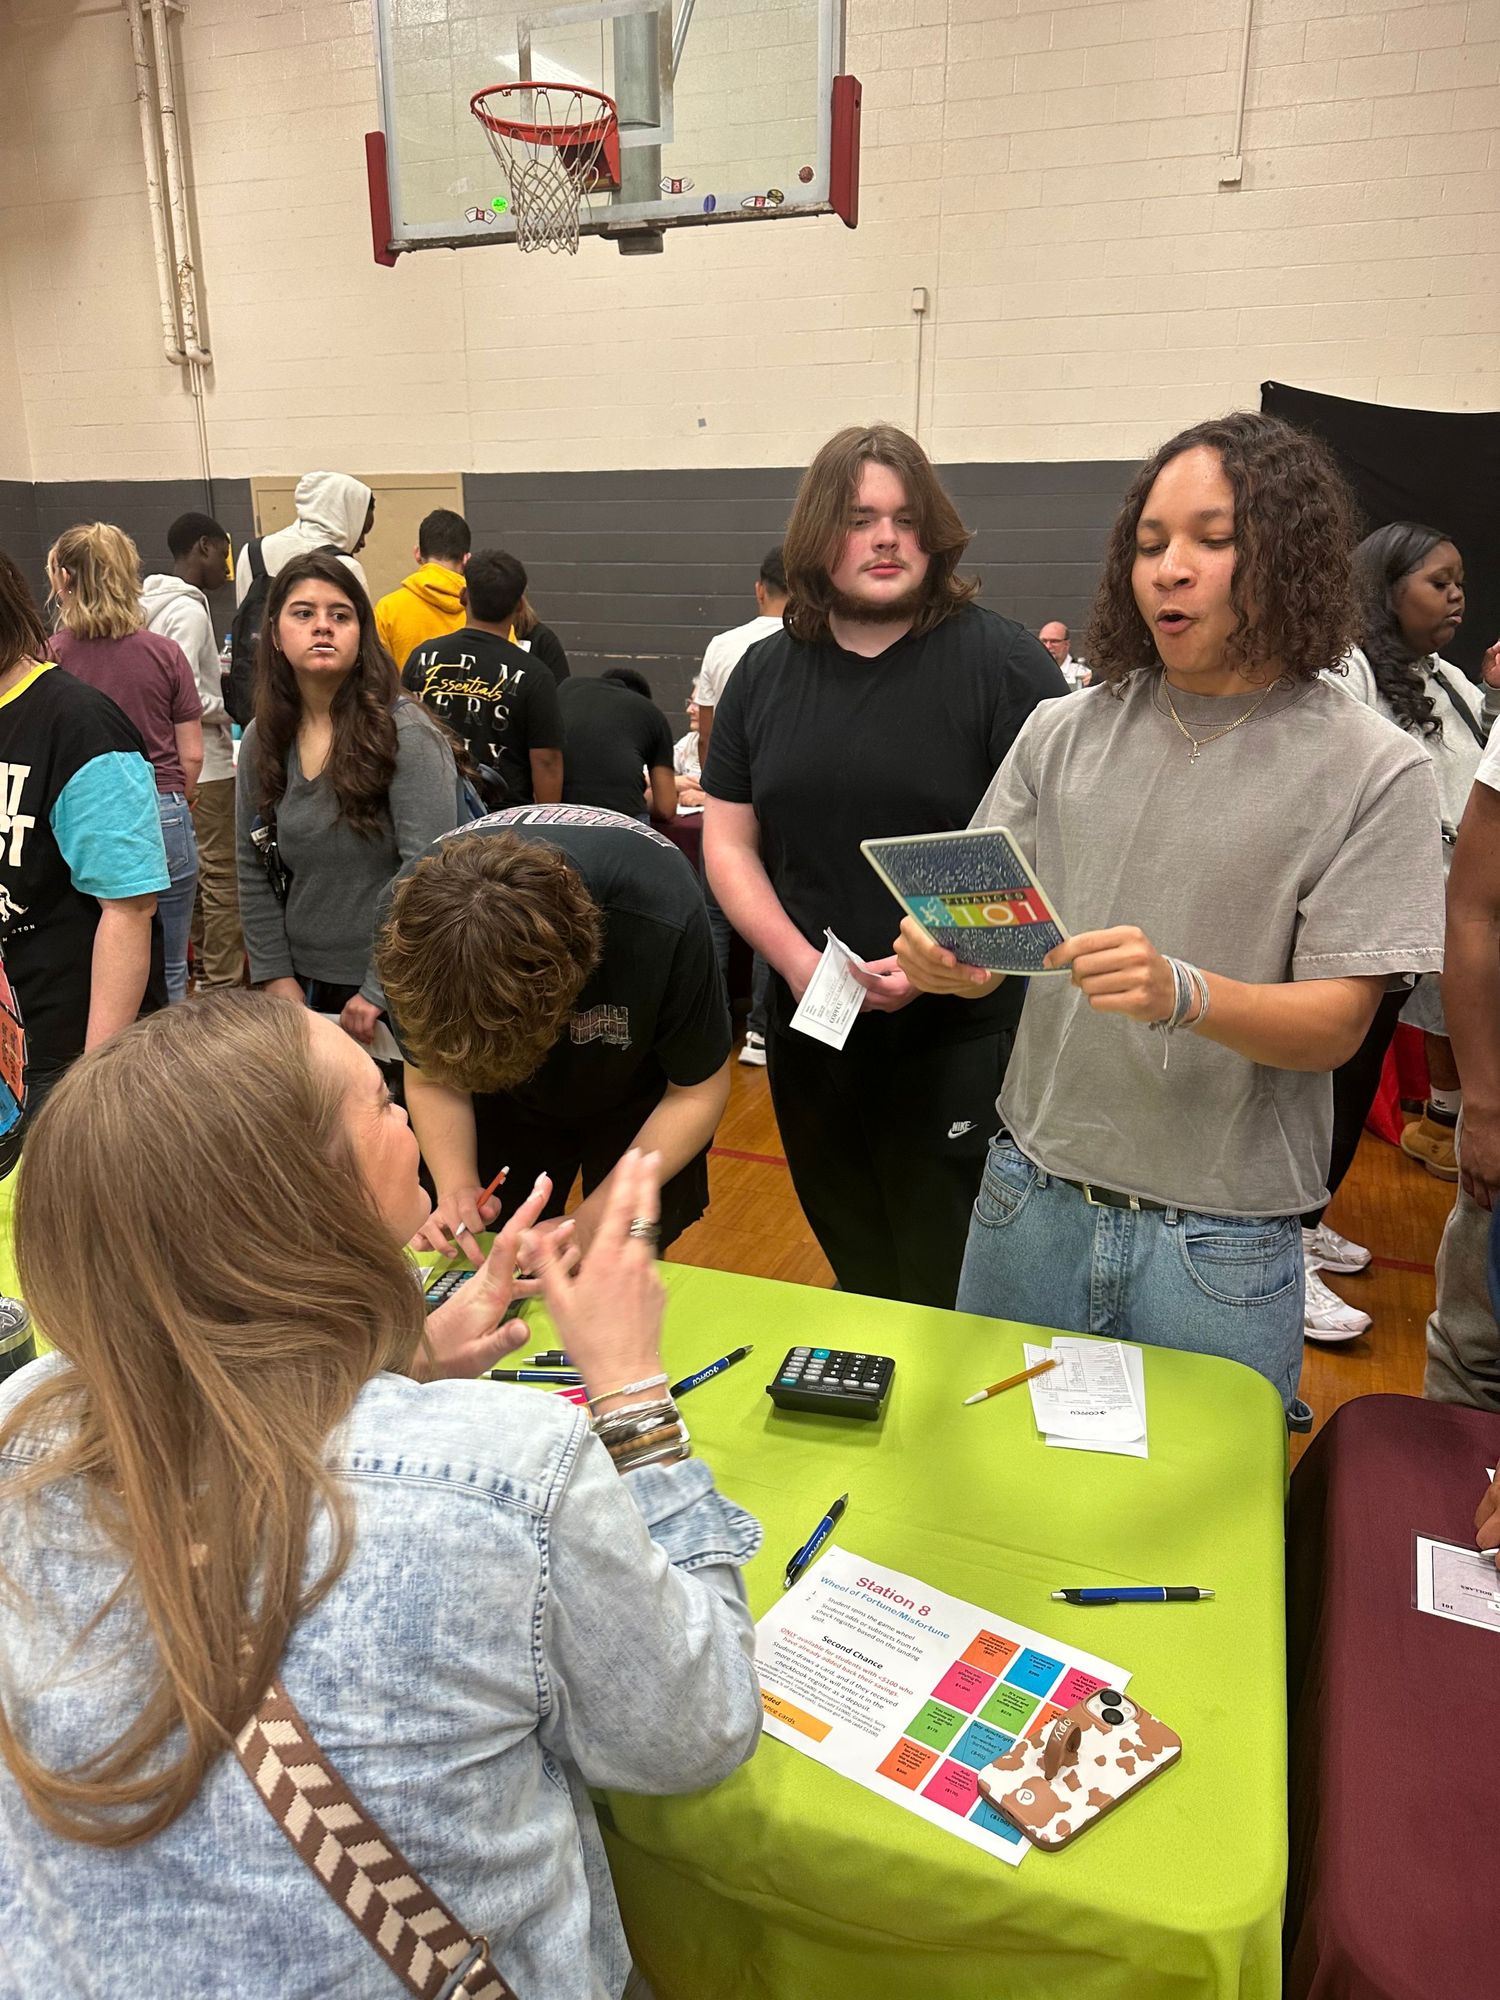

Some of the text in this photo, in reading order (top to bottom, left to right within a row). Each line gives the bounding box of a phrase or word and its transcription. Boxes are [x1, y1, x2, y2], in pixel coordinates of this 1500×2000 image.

[419, 663, 504, 703] Essentials
[957, 901, 1038, 925] 101
[951, 1120, 972, 1132] NIKE
[821, 1576, 849, 1592] Wheel
[861, 1593, 950, 1639] Fortune/Misfortune
[856, 1577, 931, 1616] Station 8
[816, 1609, 833, 1619] check
[833, 1617, 856, 1630] register
[856, 1627, 876, 1640] based
[885, 1642, 896, 1650] the
[896, 1647, 919, 1662] landing
[822, 1603, 845, 1616] Student
[844, 1614, 859, 1623] adds
[868, 1625, 895, 1641] subtracts
[896, 1639, 911, 1649] from
[912, 1646, 923, 1654] the
[828, 1597, 916, 1641] Student spins the game wheel
[780, 1628, 797, 1639] ONLY
[797, 1636, 824, 1651] available
[835, 1654, 861, 1670] students
[862, 1668, 877, 1678] with
[878, 1676, 898, 1688] <$100
[898, 1686, 913, 1695] who
[782, 1636, 798, 1646] have
[798, 1645, 821, 1659] already
[821, 1657, 842, 1669] added
[841, 1666, 856, 1676] back
[857, 1674, 873, 1684] their
[821, 1635, 883, 1669] Second Chance
[772, 1641, 796, 1656] Student
[796, 1654, 814, 1665] draws
[820, 1666, 835, 1676] card,
[836, 1675, 849, 1683] and
[855, 1683, 869, 1694] they
[870, 1691, 898, 1707] received
[774, 1651, 791, 1661] more
[791, 1659, 814, 1673] income
[814, 1671, 828, 1681] they
[841, 1686, 859, 1696] enter
[872, 1701, 884, 1709] the
[775, 1660, 807, 1678] checkbook
[807, 1677, 831, 1691] register
[760, 1693, 781, 1706] eeded
[764, 1704, 795, 1724] ance cards
[810, 1693, 825, 1703] degree
[1020, 1790, 1033, 1801] P
